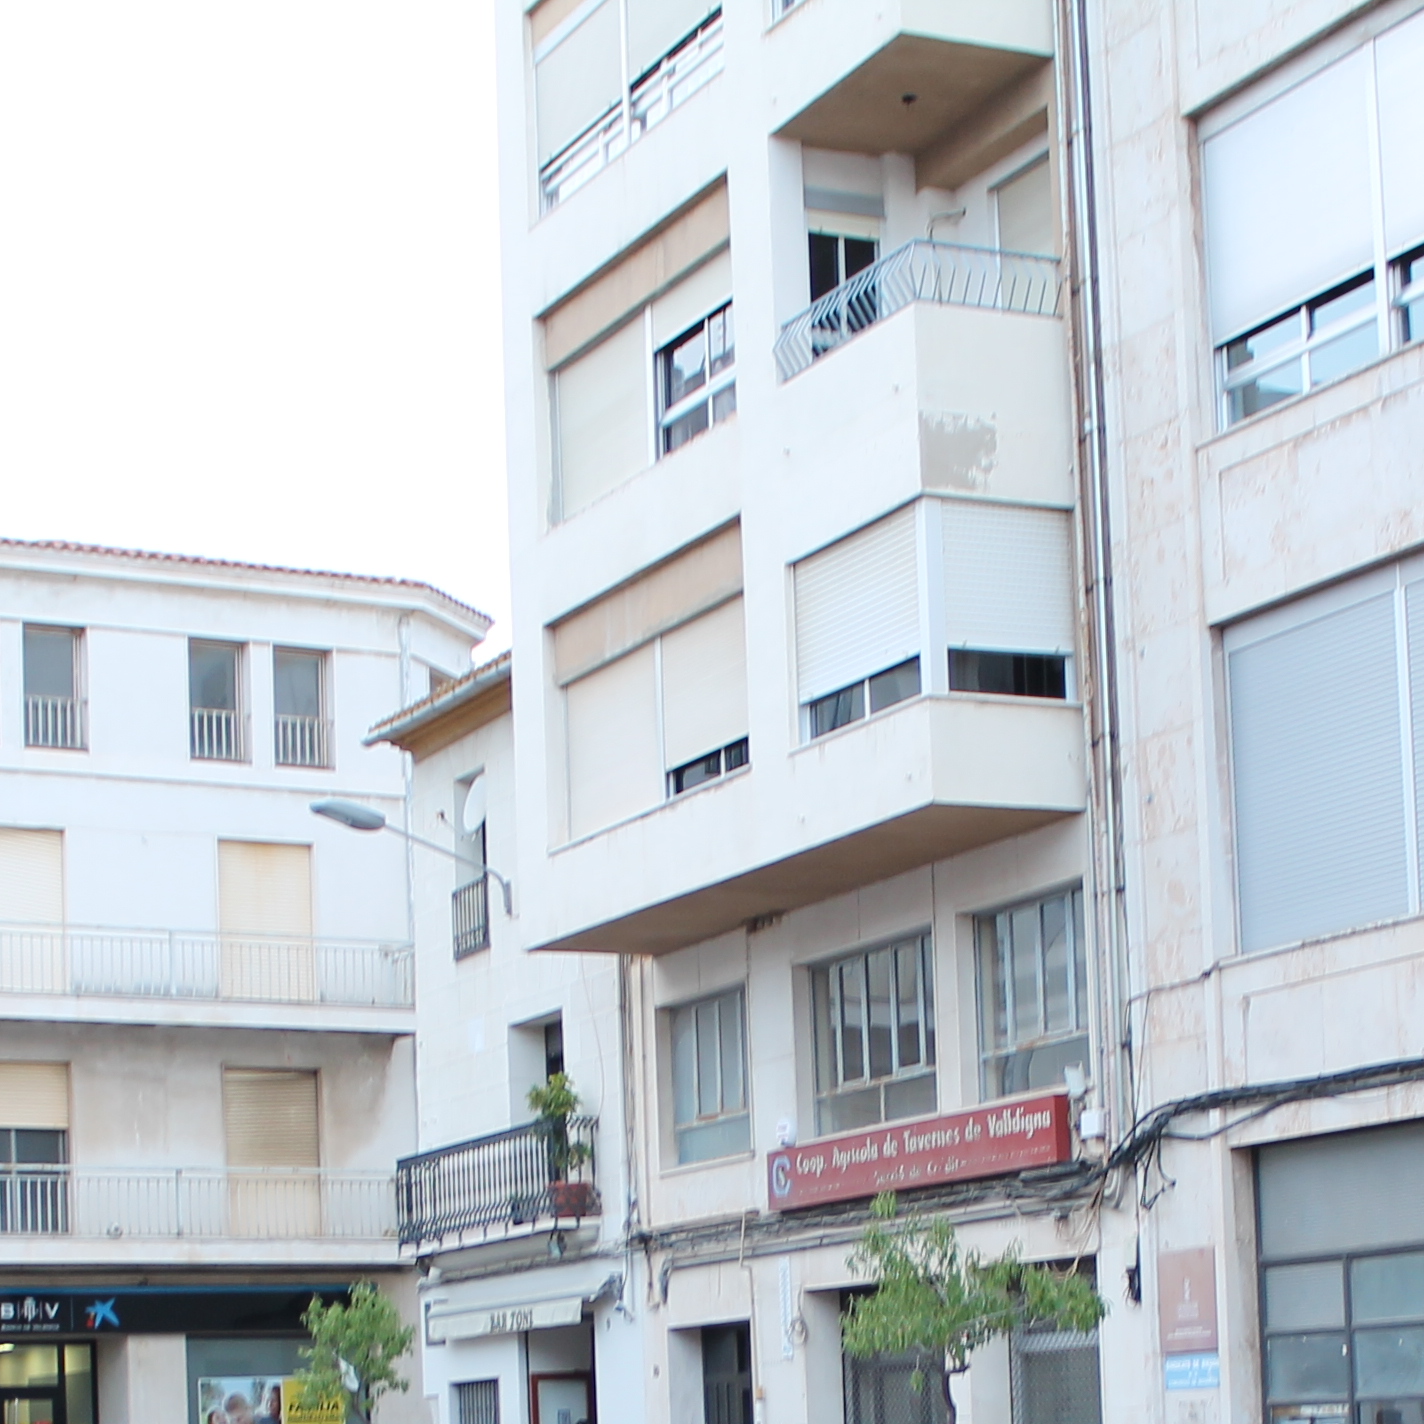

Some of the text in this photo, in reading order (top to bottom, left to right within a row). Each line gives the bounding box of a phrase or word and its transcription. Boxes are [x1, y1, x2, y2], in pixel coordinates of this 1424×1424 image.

[883, 1132, 898, 1158] de
[903, 1125, 960, 1154] Tavernes
[965, 1116, 982, 1142] de
[986, 1105, 1051, 1139] Valldigna
